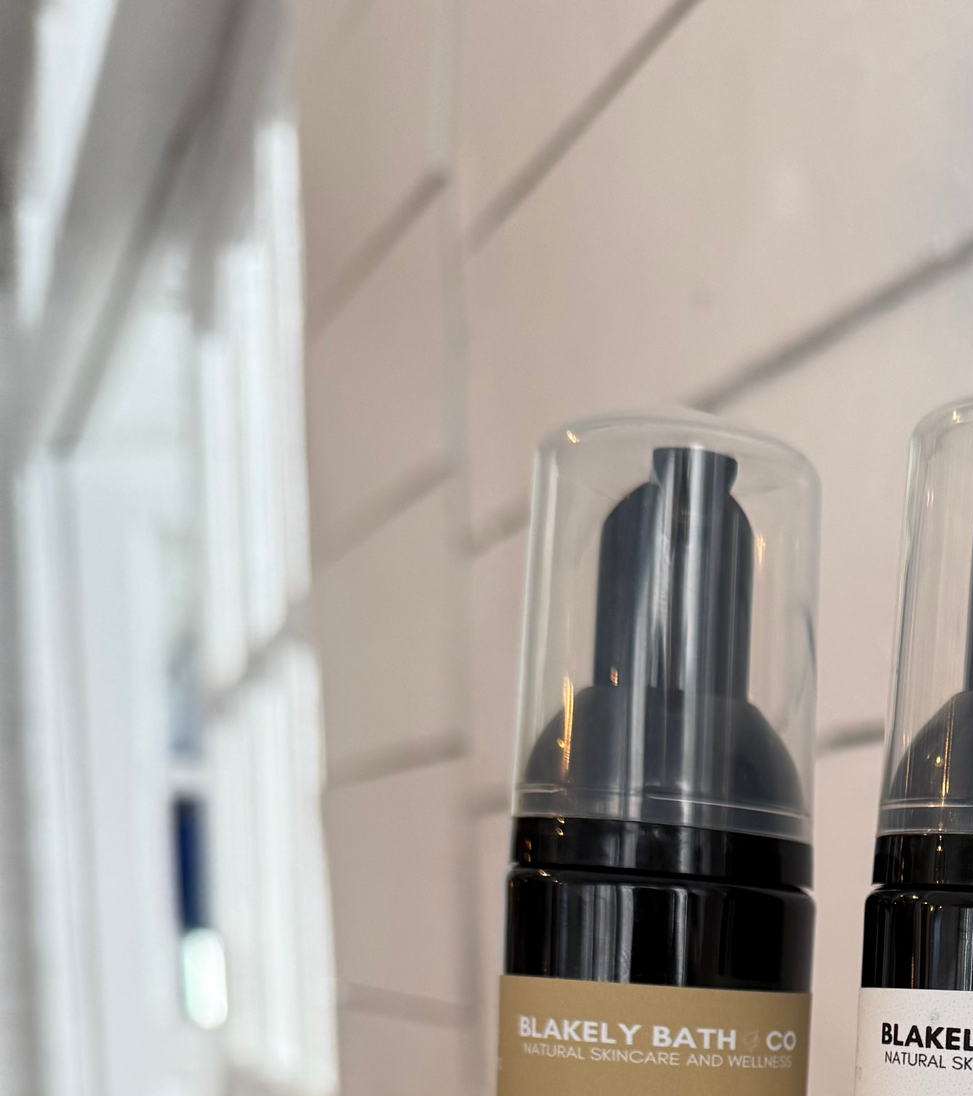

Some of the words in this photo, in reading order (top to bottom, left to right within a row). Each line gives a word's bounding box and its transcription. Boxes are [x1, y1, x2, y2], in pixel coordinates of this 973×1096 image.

[519, 1015, 641, 1046] BLAKELY
[652, 1025, 736, 1051] BATH
[766, 1030, 796, 1051] CO
[523, 1042, 585, 1061] NATURAL
[590, 1046, 680, 1066] SKINCARE
[686, 1053, 723, 1068] AND
[728, 1054, 793, 1069] WELLNESS
[884, 1050, 946, 1069] NATURAL
